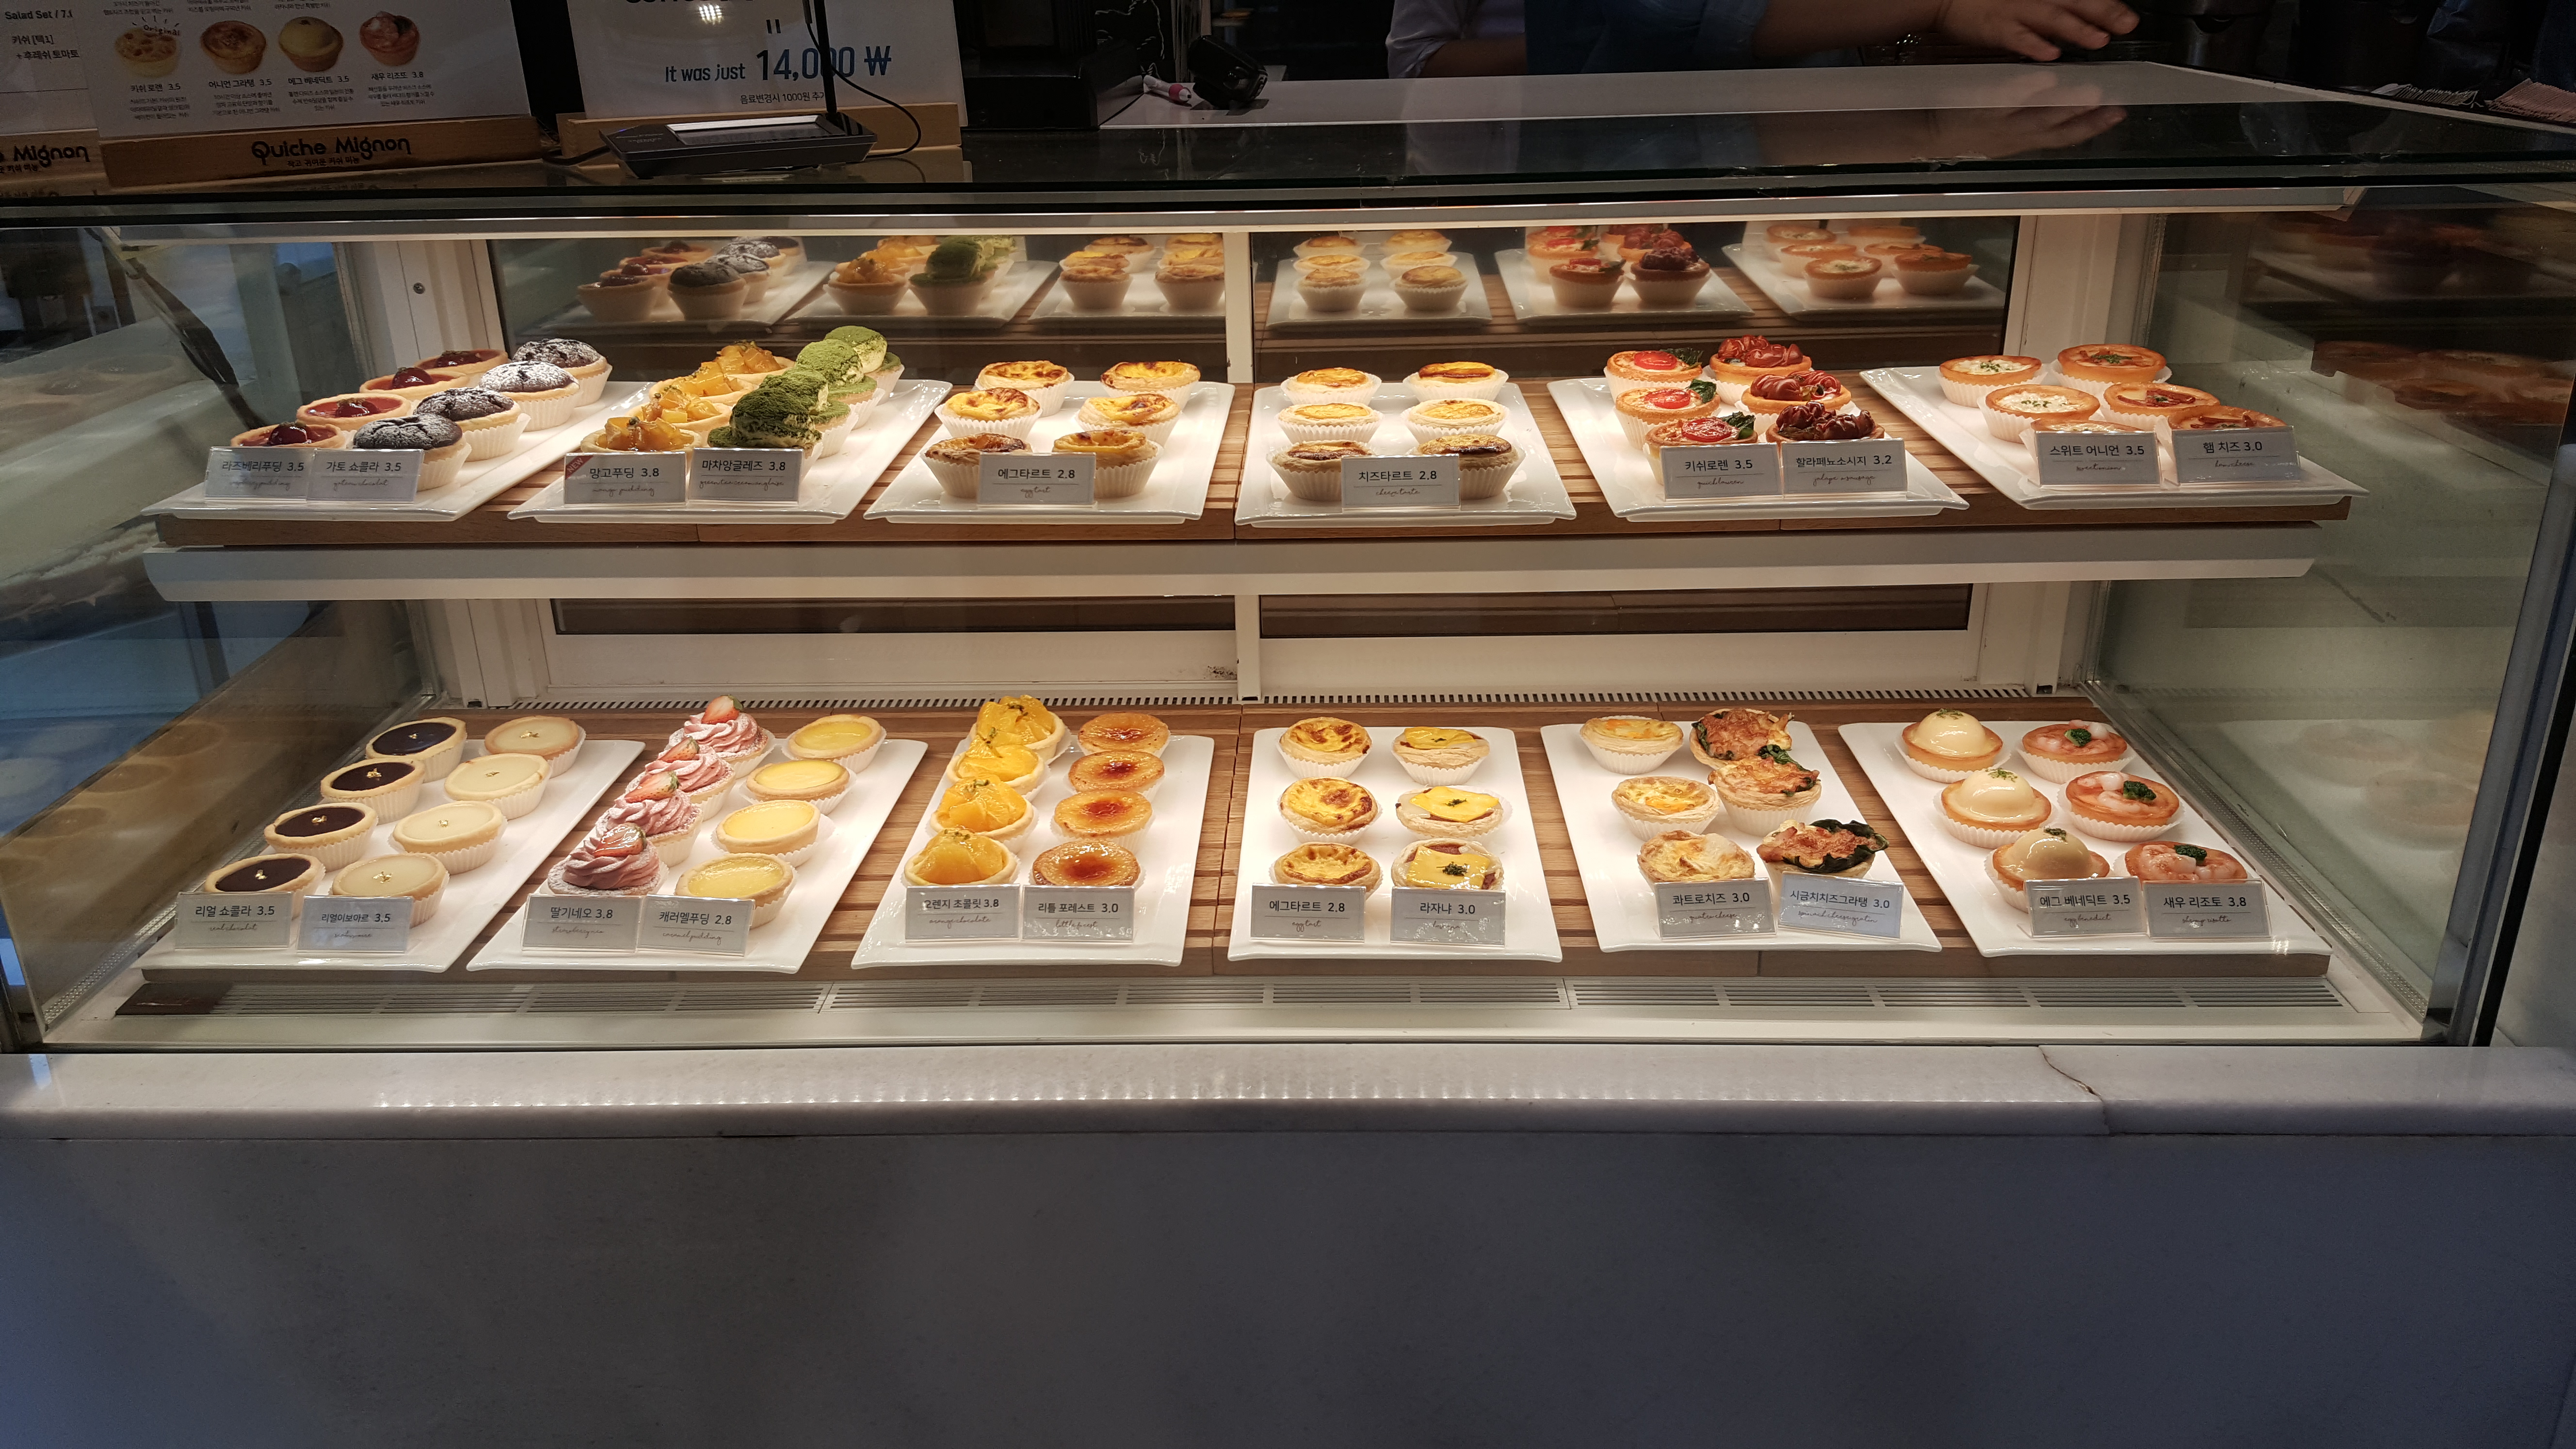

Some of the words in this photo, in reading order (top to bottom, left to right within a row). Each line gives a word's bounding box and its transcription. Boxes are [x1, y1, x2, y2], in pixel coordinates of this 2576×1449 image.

[5, 11, 33, 19] Salad
[35, 10, 53, 19] Set
[143, 25, 180, 35] Original
[52, 49, 80, 59] 토마토
[665, 65, 677, 82] It
[681, 67, 710, 81] was
[715, 63, 745, 81] just
[740, 94, 780, 104] 음료변경시
[782, 92, 810, 102] 1000원
[14, 145, 91, 167] Mignon
[252, 138, 326, 165] Quiche
[335, 136, 412, 160] Mignon
[2050, 445, 2083, 456] 스위트
[2086, 445, 2119, 456] 어니언
[2126, 446, 2144, 455] 3.5
[2203, 442, 2215, 453] 햄
[2218, 441, 2241, 452] 치즈
[2243, 441, 2262, 451] 3.0
[222, 461, 282, 472] 라즈베리푸딩
[287, 462, 304, 471] 3.5
[326, 461, 345, 472] 가토
[385, 462, 402, 471] 3.5
[566, 458, 583, 473] NEW
[702, 460, 763, 471] 마차앙글레즈
[769, 462, 786, 471] 3.8
[1685, 459, 1728, 472] 키쉬로렌
[1735, 459, 1753, 469] 3.5
[1796, 456, 1866, 468] 할라페뇨소시지
[1873, 455, 1892, 465] 3.2
[590, 467, 634, 479] 망고푸딩
[641, 468, 659, 477] 3.8
[998, 468, 1051, 479] 에그타르트
[1057, 469, 1075, 479] 2.8
[1359, 471, 1413, 482] 치즈타르트
[1419, 470, 1437, 480] 2.8
[953, 899, 981, 909] 초콜릿
[983, 899, 999, 908] 3.8
[1673, 893, 1727, 906] 콰트로치즈
[1732, 892, 1750, 902] 3.0
[1790, 890, 1868, 907] 시금치치즈그라탱
[1873, 899, 1890, 908] 3.0
[2040, 896, 2062, 907] 에그
[2064, 895, 2108, 907] 베네딕트
[2113, 894, 2130, 904] 3.5
[2163, 897, 2186, 908] 새우
[2189, 897, 2222, 908] 리조토
[2228, 897, 2246, 907] 3.8
[195, 905, 216, 917] 리얼
[219, 905, 252, 917] 쇼콜라
[257, 906, 275, 916] 3.5
[551, 907, 592, 918] 딸기네오
[595, 909, 613, 918] 3.8
[1038, 903, 1056, 913] 리틀
[1059, 903, 1095, 913] 포레스트
[1102, 903, 1118, 913] 3.0
[1269, 901, 1321, 912] 에그타르트
[1328, 902, 1345, 912] 2.8
[1420, 902, 1452, 915] 라자냐
[1458, 904, 1475, 914] 3.0
[374, 913, 391, 923] 3.5
[659, 912, 709, 925] 캐러멜푸딩
[715, 915, 732, 925] 2.8
